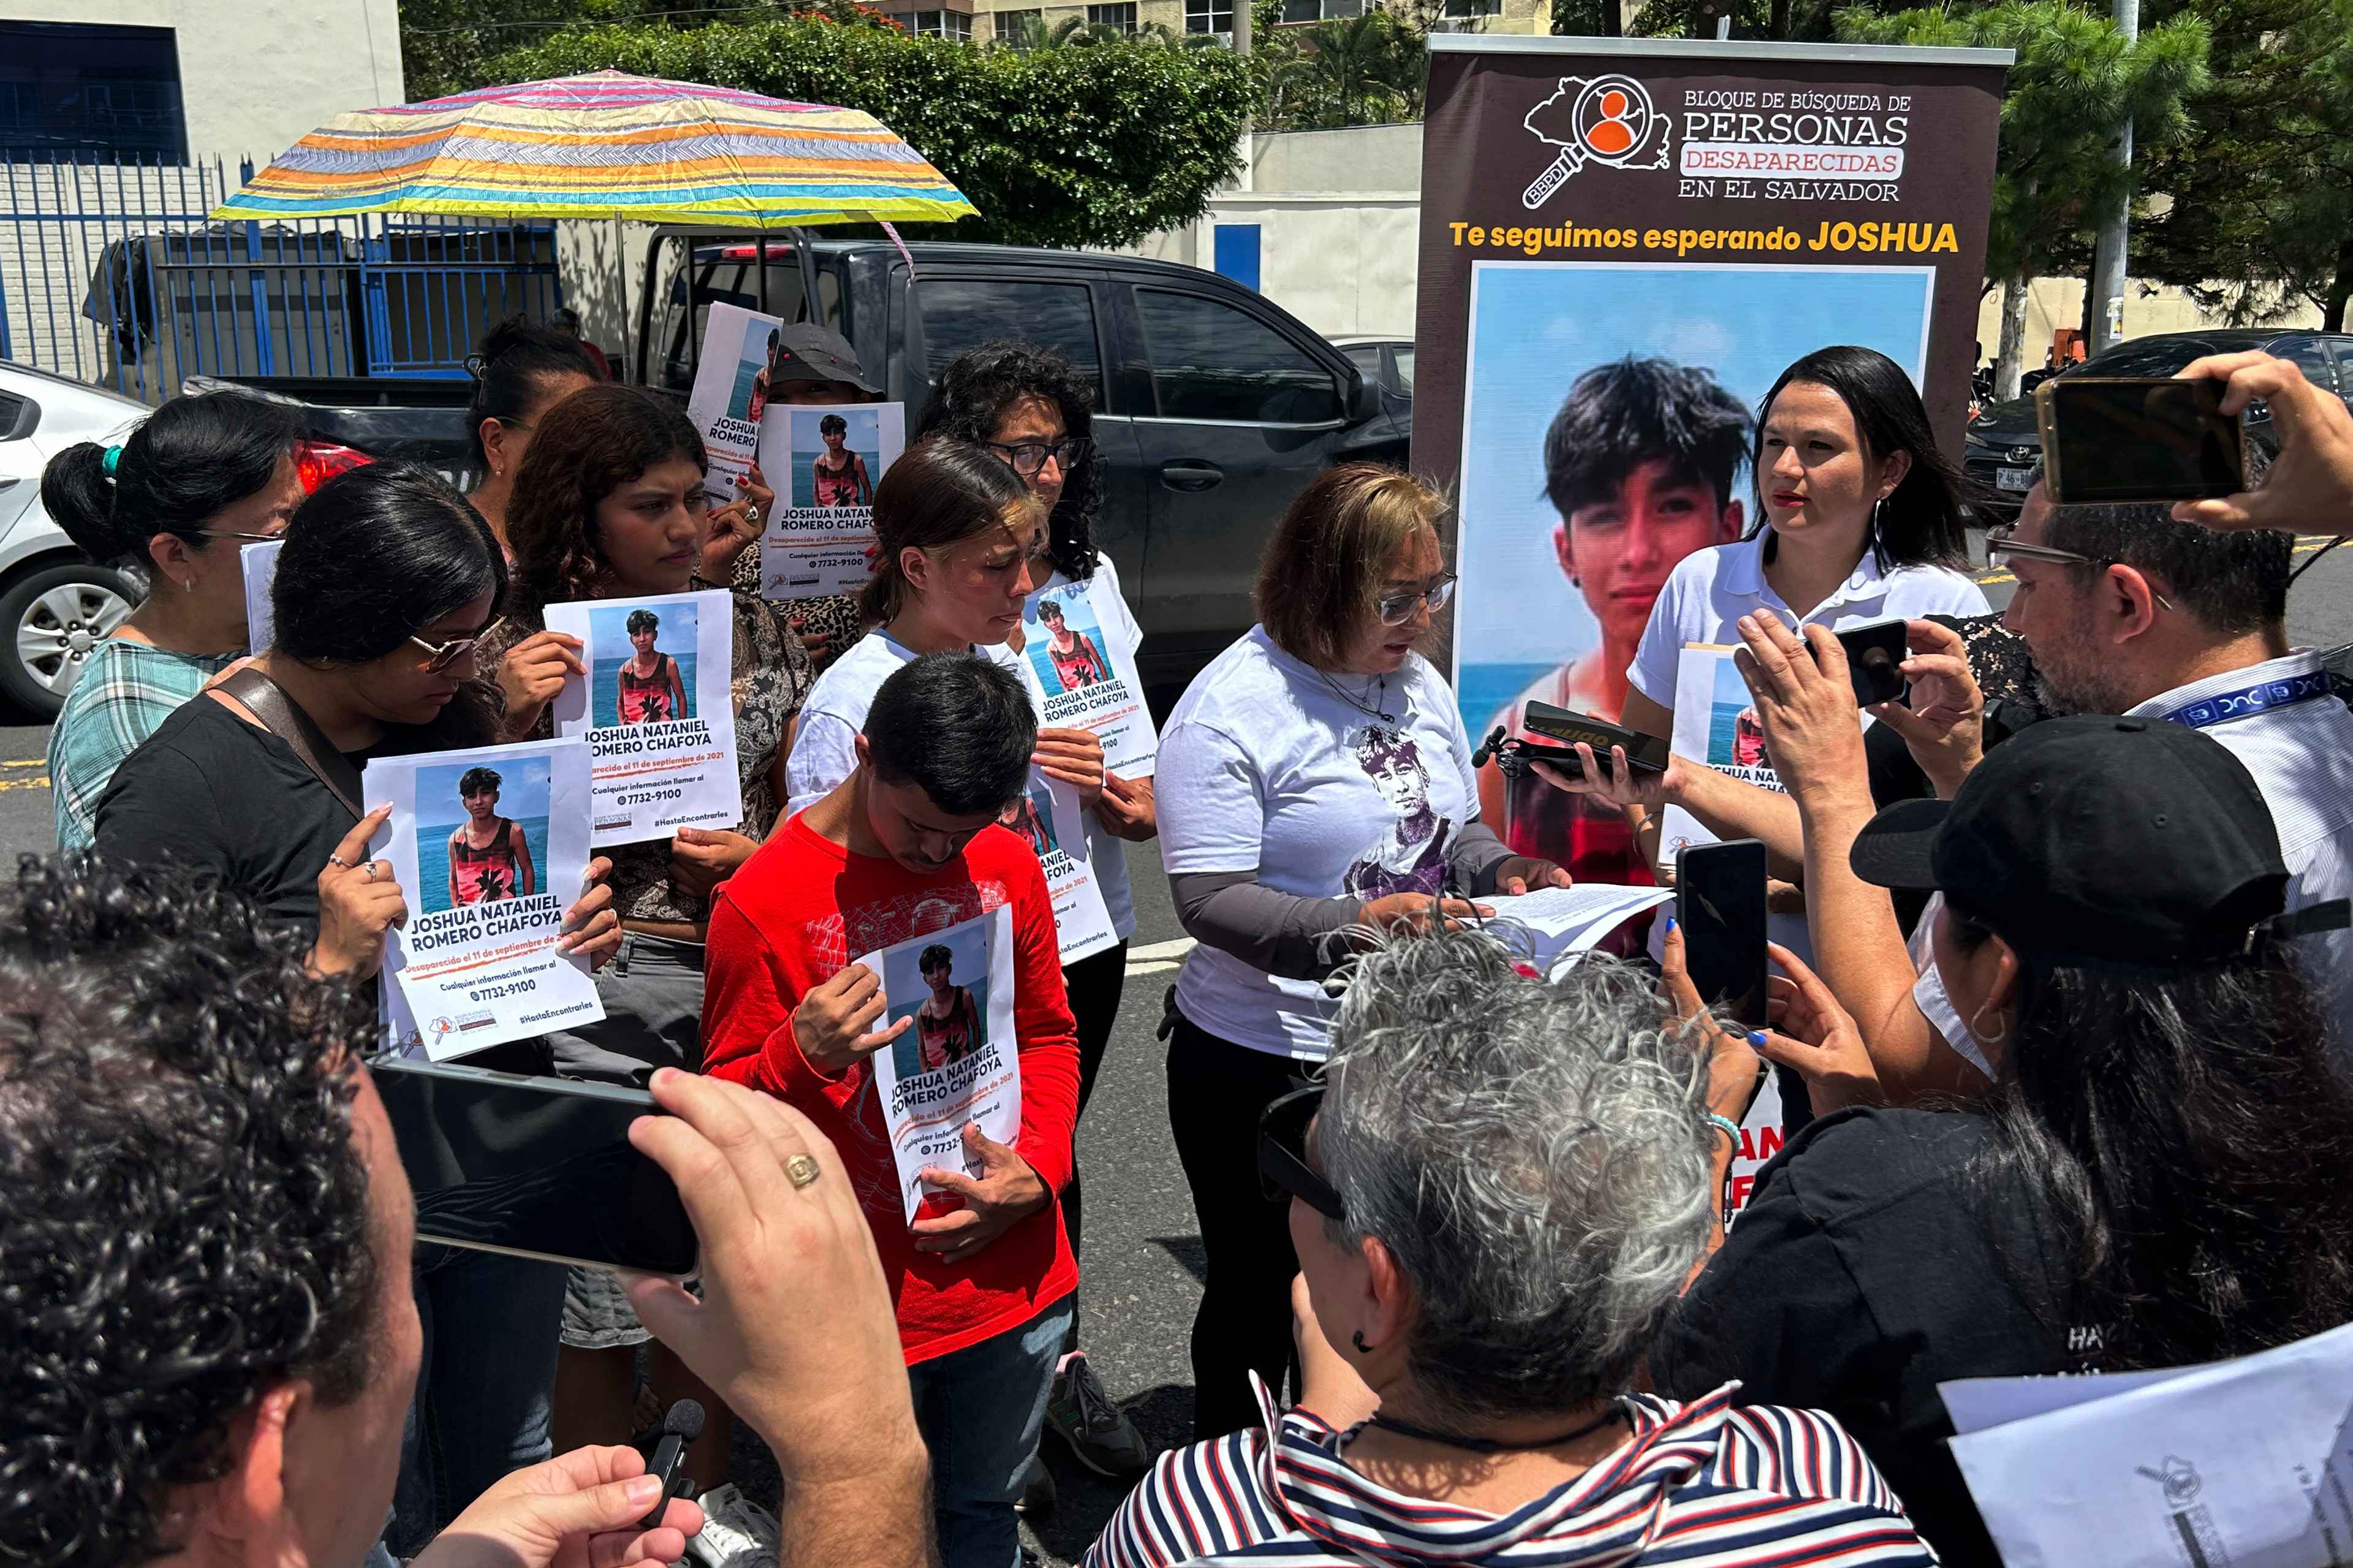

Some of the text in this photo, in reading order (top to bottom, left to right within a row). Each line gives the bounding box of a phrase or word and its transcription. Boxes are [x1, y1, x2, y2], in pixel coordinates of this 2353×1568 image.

[1684, 90, 1911, 113] BLOQUE DE BÚSQUEDA DE
[1681, 113, 1908, 145] PERSONAS
[1685, 151, 1897, 173] DESAPARECIDAS
[1528, 169, 1562, 203] BBPD
[1678, 180, 1900, 202] EN EL SALVADOR
[1449, 220, 1959, 257] Te seguimos esperando JOSHUA
[709, 428, 755, 447] ROMERO
[714, 417, 756, 436] JOSHUA
[781, 520, 874, 530] ROMERO CHAF
[783, 509, 873, 519] JOSHUA NATAN
[818, 558, 863, 568] 7732-9100
[1044, 680, 1126, 711] JOSHUA NATANIEL
[1045, 691, 1129, 722] ROMERO CHAFOYA
[643, 720, 709, 738] NATANIEL
[592, 733, 712, 757] OMERO CHAFOYA
[1099, 738, 1118, 749] -9100
[592, 751, 724, 773] arecido el 11 de septiembre de 2021
[1706, 766, 1751, 780] HUA
[592, 783, 628, 795] Cualquier
[629, 778, 672, 791] información
[673, 776, 695, 785] llamar
[627, 788, 681, 805] 7732-9100
[654, 811, 729, 827] #HastaEncontrarles
[1040, 850, 1070, 869] ANIEL
[1046, 862, 1075, 882] FOYA
[1073, 876, 1088, 885] 2021
[411, 895, 561, 934] JOSHUA NATANIEL
[1054, 905, 1069, 915] amar
[411, 911, 562, 952] ROMERO CHAFOYA
[1058, 931, 1107, 954] taEncontrarles
[405, 956, 461, 973] Desaparecido
[464, 952, 471, 962] el
[472, 950, 481, 960] 11
[483, 949, 493, 958] de
[494, 939, 542, 956] septiembre
[544, 935, 555, 945] de
[440, 960, 556, 991] Cualquier información llamar al
[480, 979, 536, 1001] 7732-9100
[520, 1001, 593, 1025] #HastaEncontrarles
[892, 1043, 999, 1102] JOSHUA NATANIEL
[990, 1080, 999, 1089] de
[999, 1071, 1013, 1085] 2021
[892, 1056, 1002, 1119] ROMERO CHAFOYA
[972, 1107, 993, 1121] llamar
[993, 1101, 1000, 1110] al
